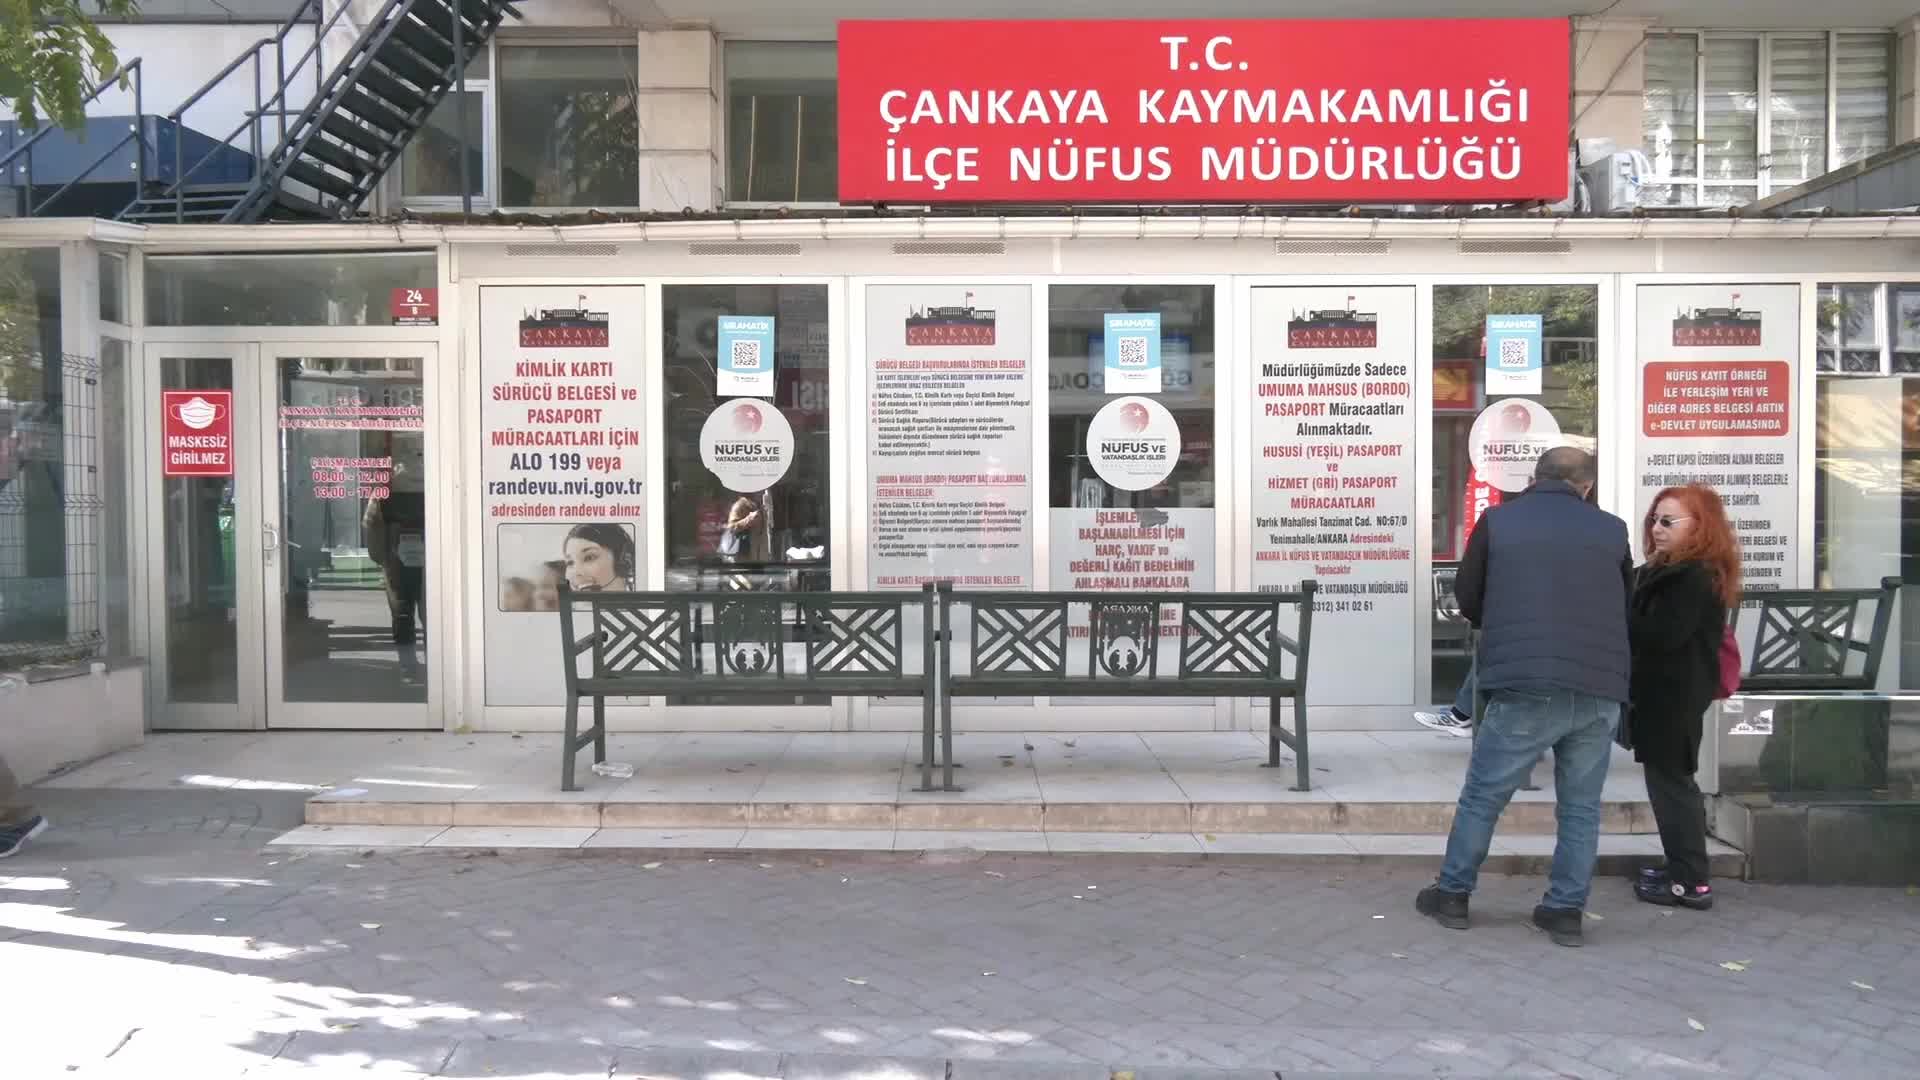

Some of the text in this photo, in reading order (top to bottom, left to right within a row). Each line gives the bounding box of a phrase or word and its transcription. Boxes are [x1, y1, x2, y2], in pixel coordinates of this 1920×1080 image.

[1160, 36, 1248, 70] T.C.
[879, 79, 1527, 132] ÇANKAYA KAYMAKAMLIĞI
[886, 138, 1521, 188] İLÇE NÜFUS MÜDÜRLÜĞÜ
[407, 290, 423, 302] 24
[517, 359, 612, 376] KİMLİK KARTI
[1263, 363, 1406, 379] Müdürlüğümüzde Sadece
[1666, 369, 1766, 380] NÜFUS KAYIT ÖRNEĞİ
[493, 382, 637, 400] SÜRÜCÜ BELGESİ ve
[1259, 382, 1410, 398] UMUMA MAHSUS (BORDO)
[1664, 385, 1768, 400] İLE YERLEŞİM YERİ VE
[1266, 403, 1404, 416] PASAPORT Müracaatları
[1648, 402, 1784, 414] DİĞER ADRES BELGESİ ARTIK
[528, 409, 602, 423] PASAPORT
[1297, 423, 1372, 436] Alınmaktadır.
[1651, 419, 1780, 431] e-DEVLET UYGULAMASINDA
[169, 433, 227, 448] MASKESİZ
[492, 428, 638, 449] MÜRACAATLARI İÇİN
[715, 444, 779, 455] NÜFUS VE
[1102, 442, 1166, 453] NÜFUS VE
[1263, 442, 1402, 460] HUSUSİ (YEŞİL) PASAPORT
[1483, 444, 1530, 455] NÜFUS
[171, 450, 226, 464] GİRİLMEZ
[510, 453, 621, 473] ALO 199 veya
[1327, 463, 1338, 472] ve
[312, 472, 389, 482] 08.00 12.00
[1268, 475, 1397, 490] HİZMET (GRİ) PASAPORT
[314, 487, 390, 498] 13.00 17.00
[489, 478, 641, 498] randevu.nvi.gov.tr
[1291, 495, 1375, 509] MÜRACAATLARI
[492, 503, 640, 517] adresinden randevu alınız
[1257, 516, 1407, 527] Varlık Mahallesi Tanzimat Cad. NO:67/D
[1079, 525, 1184, 542] BAŞLANABİLMESİ İÇİN
[1270, 533, 1393, 544] Yenimahalle/ANKARA Adresindeki
[1780, 536, 1787, 545] VE
[1096, 544, 1168, 558] HARÇ, VAKIF ve
[1256, 551, 1280, 561] ANKARA
[1290, 550, 1310, 560] NÜFUS
[1312, 551, 1319, 560] VE
[1777, 552, 1784, 561] VE
[1070, 559, 1109, 572] DEĞERLİ
[1114, 559, 1141, 572] KAĞIT
[1133, 577, 1189, 588] BANKALARA
[1336, 602, 1349, 611] 341
[1352, 602, 1362, 611] 02
